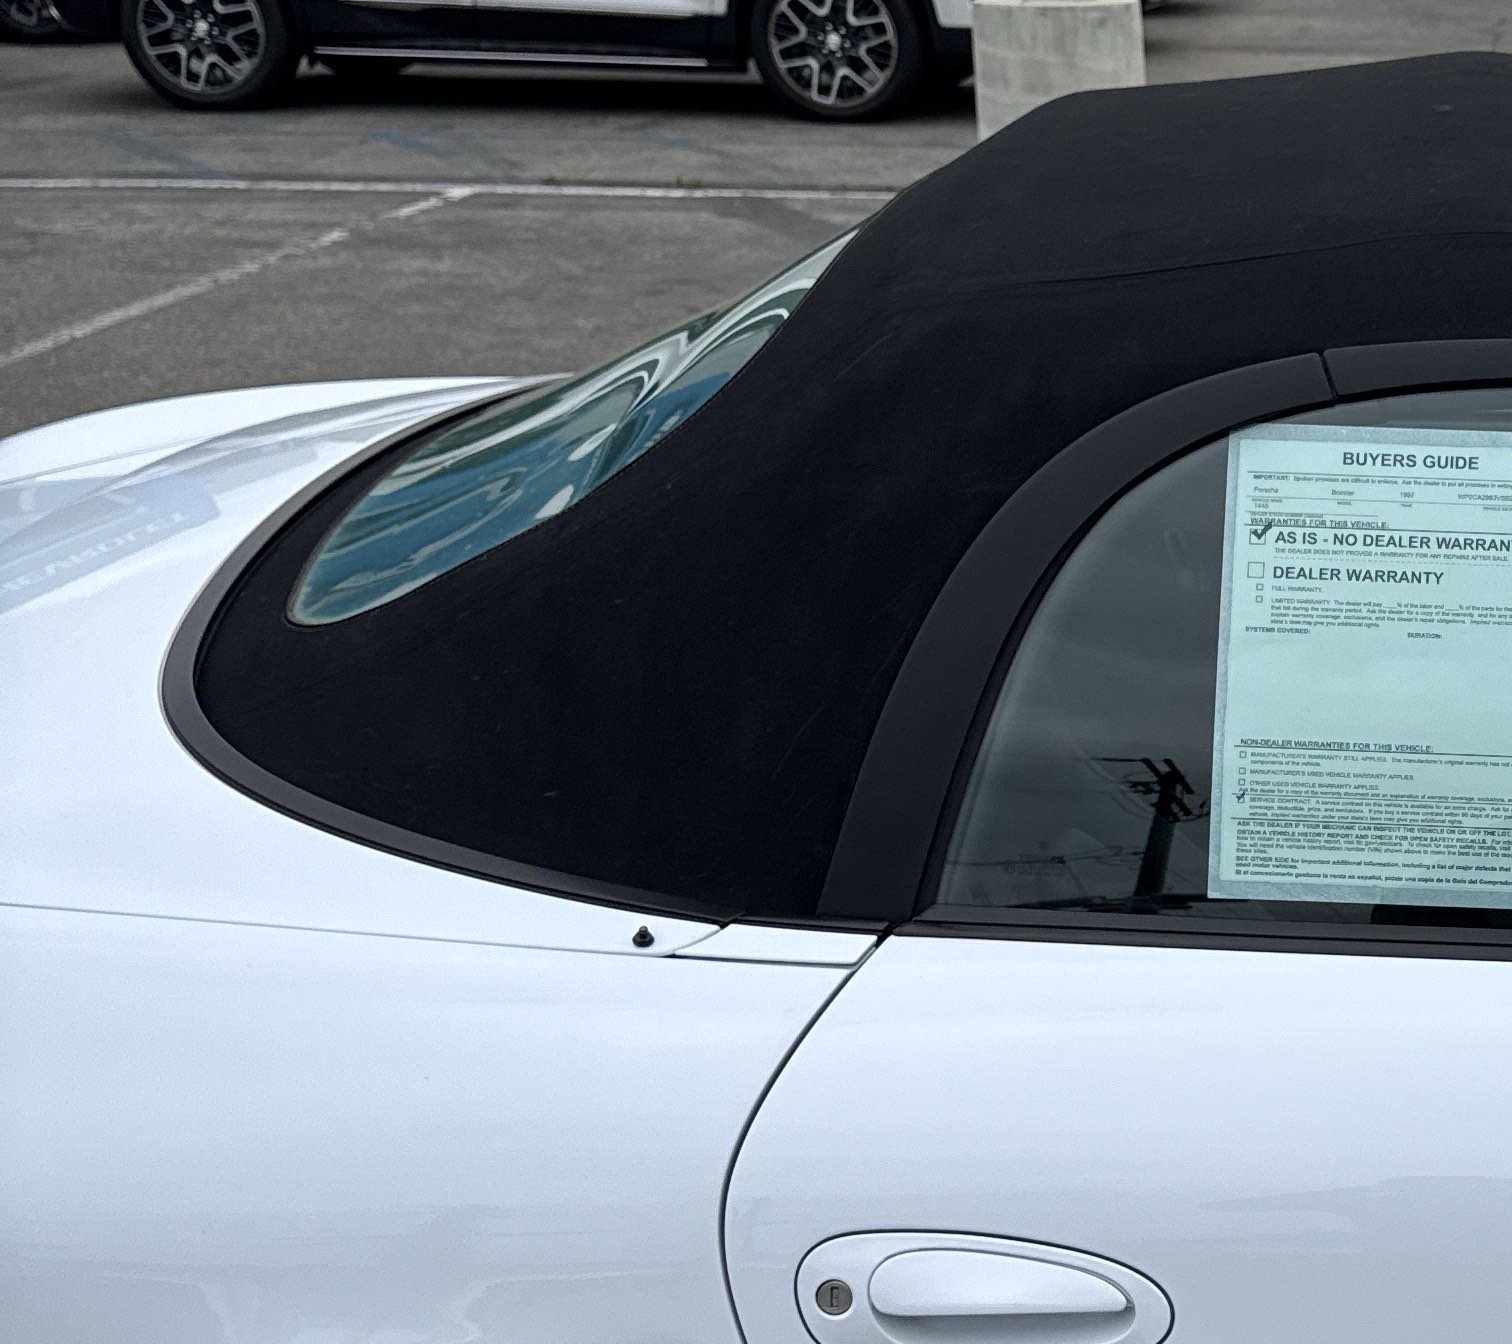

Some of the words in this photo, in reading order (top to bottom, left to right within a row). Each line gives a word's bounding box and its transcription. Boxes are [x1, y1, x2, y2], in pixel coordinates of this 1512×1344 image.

[1343, 452, 1417, 469] BUYERS
[1423, 455, 1480, 471] GUIDE
[1250, 517, 1306, 527] WARRANTIES
[1309, 519, 1327, 527] FOR
[1330, 520, 1348, 528] THIS
[1351, 520, 1390, 529] VEHICLE:
[1274, 531, 1297, 545] AS
[1302, 532, 1318, 545] IS
[1333, 533, 1358, 546] NO
[1363, 534, 1431, 549] DEALER
[1273, 566, 1342, 581] DEALER
[1347, 568, 1445, 585] WARRANTY
[1245, 626, 1275, 634] SYSTEMS
[1277, 626, 1311, 635] COVERED:
[1240, 738, 1292, 749] NON-DEALER
[1294, 740, 1350, 750] WARRANTIES
[1353, 742, 1370, 751] FOR
[1374, 743, 1392, 752] THIS
[1395, 744, 1434, 753] VEHICLE:
